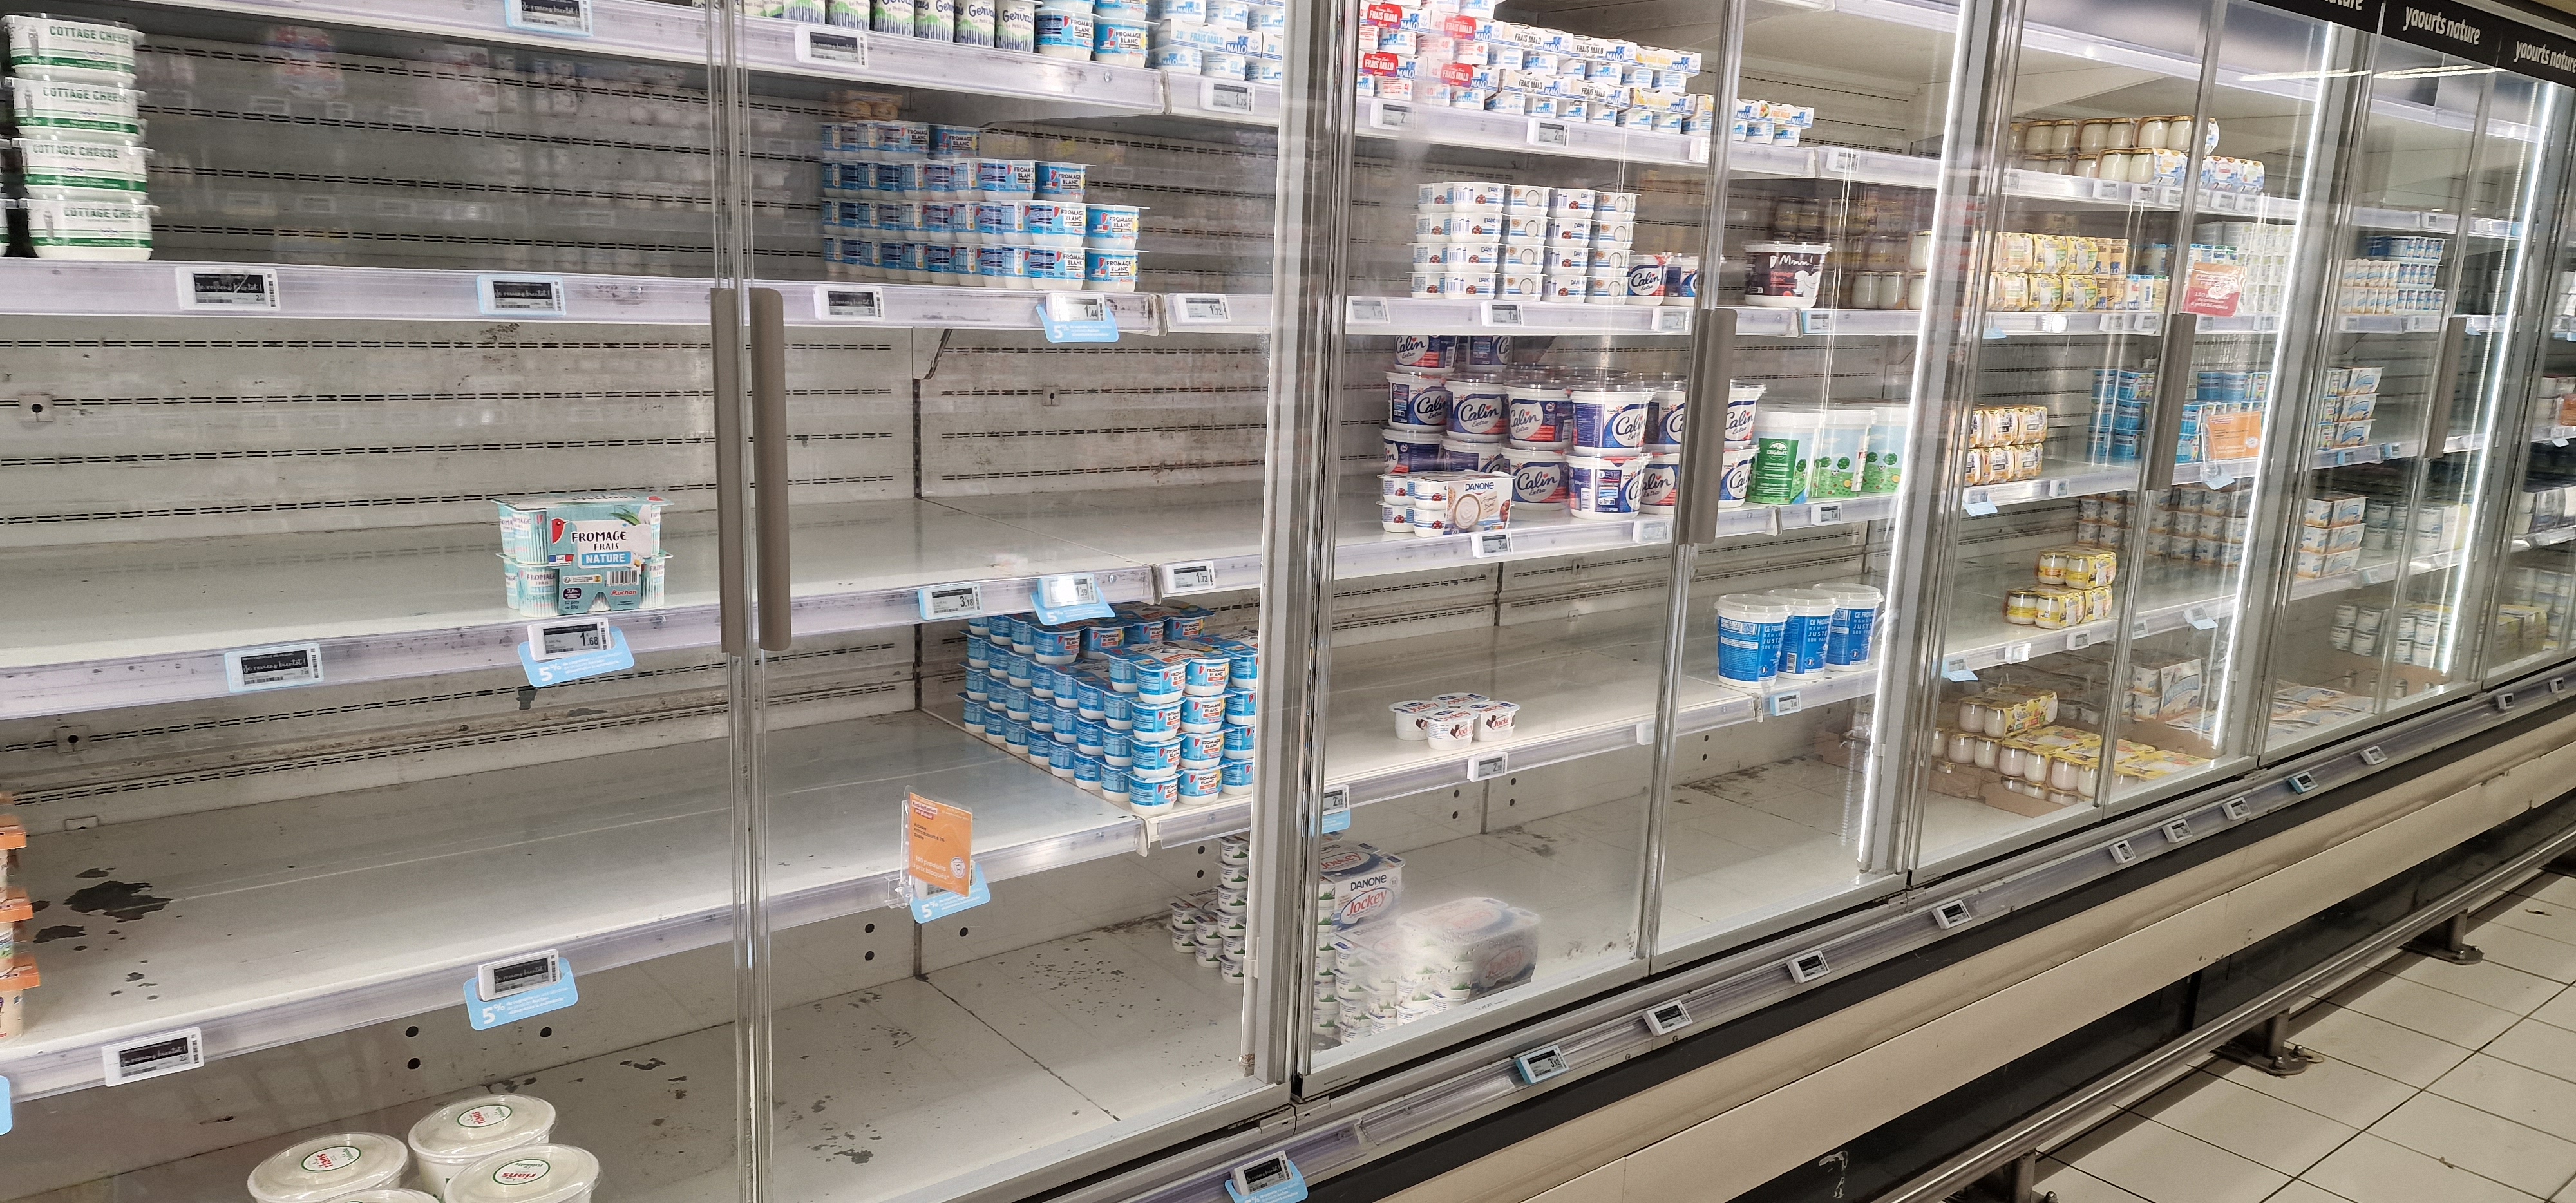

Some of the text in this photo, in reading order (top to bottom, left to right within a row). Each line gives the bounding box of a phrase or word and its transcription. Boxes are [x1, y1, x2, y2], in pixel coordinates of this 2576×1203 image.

[1369, 10, 1398, 23] FRAIS MALO
[1400, 21, 1419, 31] MALO
[1446, 22, 1473, 34] FRAIS MALO
[2402, 6, 2481, 45] yaourts nature
[49, 25, 96, 40] COTTAGE
[1475, 32, 1492, 42] MALO
[1190, 33, 1224, 46] FRAIS MALO
[1515, 33, 1542, 45] FRAIS MALO
[1226, 43, 1248, 55] MALO
[1543, 42, 1560, 52] MALO
[1576, 44, 1589, 53] FRAIS
[1606, 52, 1624, 61] MALO
[2512, 40, 2576, 74] yaourts nature
[1364, 59, 1394, 71] FRAIS MALO
[1672, 62, 1689, 71] MALO
[1396, 69, 1415, 79] MALO
[1443, 70, 1469, 81] FRAIS MALO
[1471, 79, 1488, 88] MALO
[42, 87, 90, 100] COTTAGE
[1544, 86, 1560, 96] MALO
[1671, 103, 1685, 112] MALO
[32, 144, 119, 159] COTTAGE CHEESE
[63, 207, 110, 218] COTTAGE
[1631, 272, 1660, 287] Calin
[1395, 334, 1426, 354] Calin
[1460, 403, 1500, 422] Calin
[1510, 408, 1540, 428] Calin
[1465, 481, 1495, 491] DANONE
[1517, 471, 1558, 491] Calin
[571, 531, 627, 544] FROMAGE
[594, 542, 619, 551] FRAIS
[585, 553, 625, 564] NATURE
[923, 857, 947, 872] produits
[1350, 873, 1387, 892] DANONE
[1345, 890, 1388, 917] Jockey
[317, 1153, 334, 1169] rians
